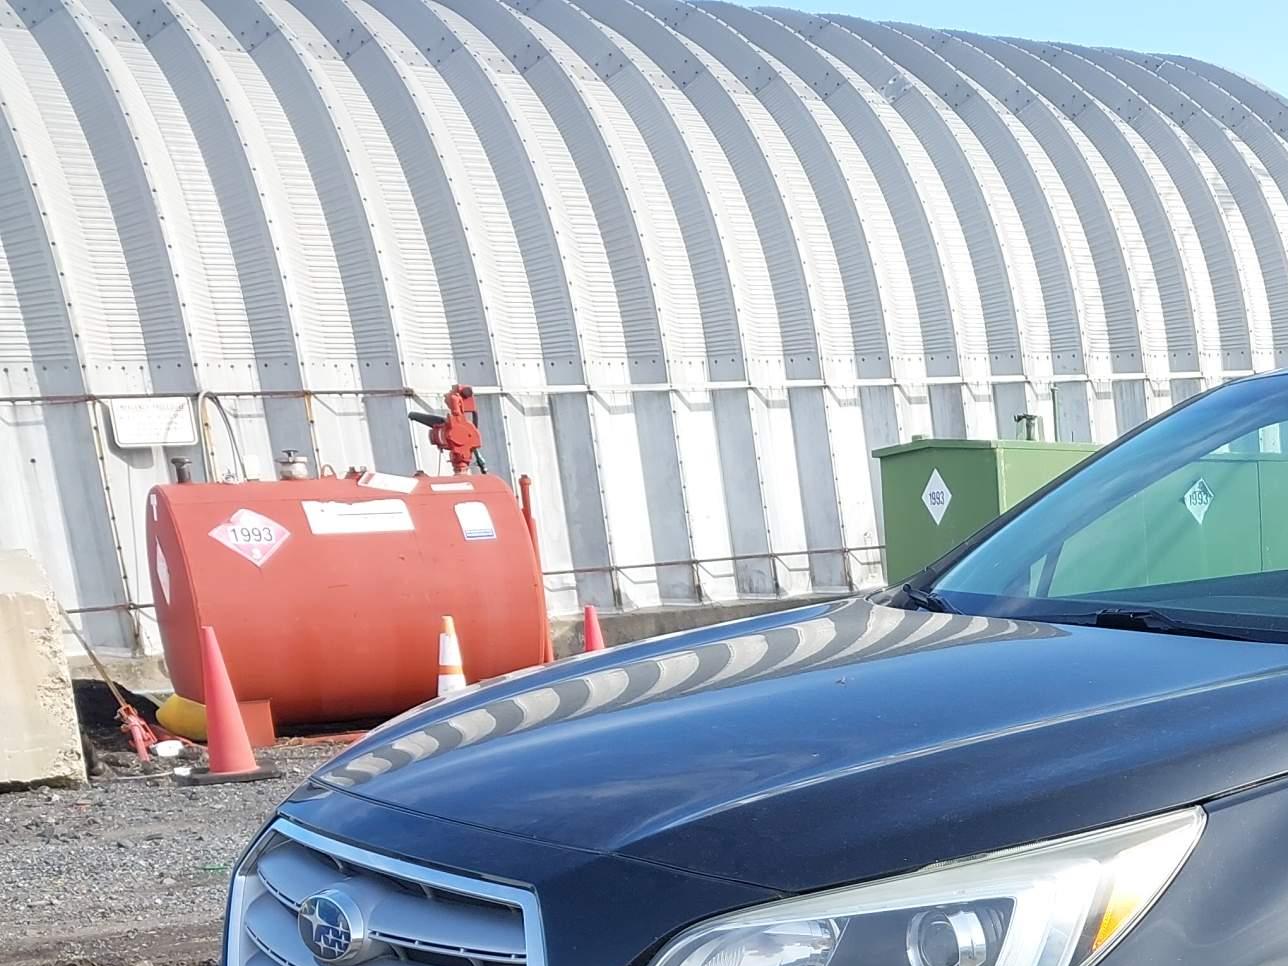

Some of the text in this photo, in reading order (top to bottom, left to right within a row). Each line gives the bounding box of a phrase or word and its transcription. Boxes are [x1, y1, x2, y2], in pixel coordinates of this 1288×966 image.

[929, 490, 945, 506] 1993
[1189, 490, 1209, 506] 1993
[230, 527, 273, 543] 1993
